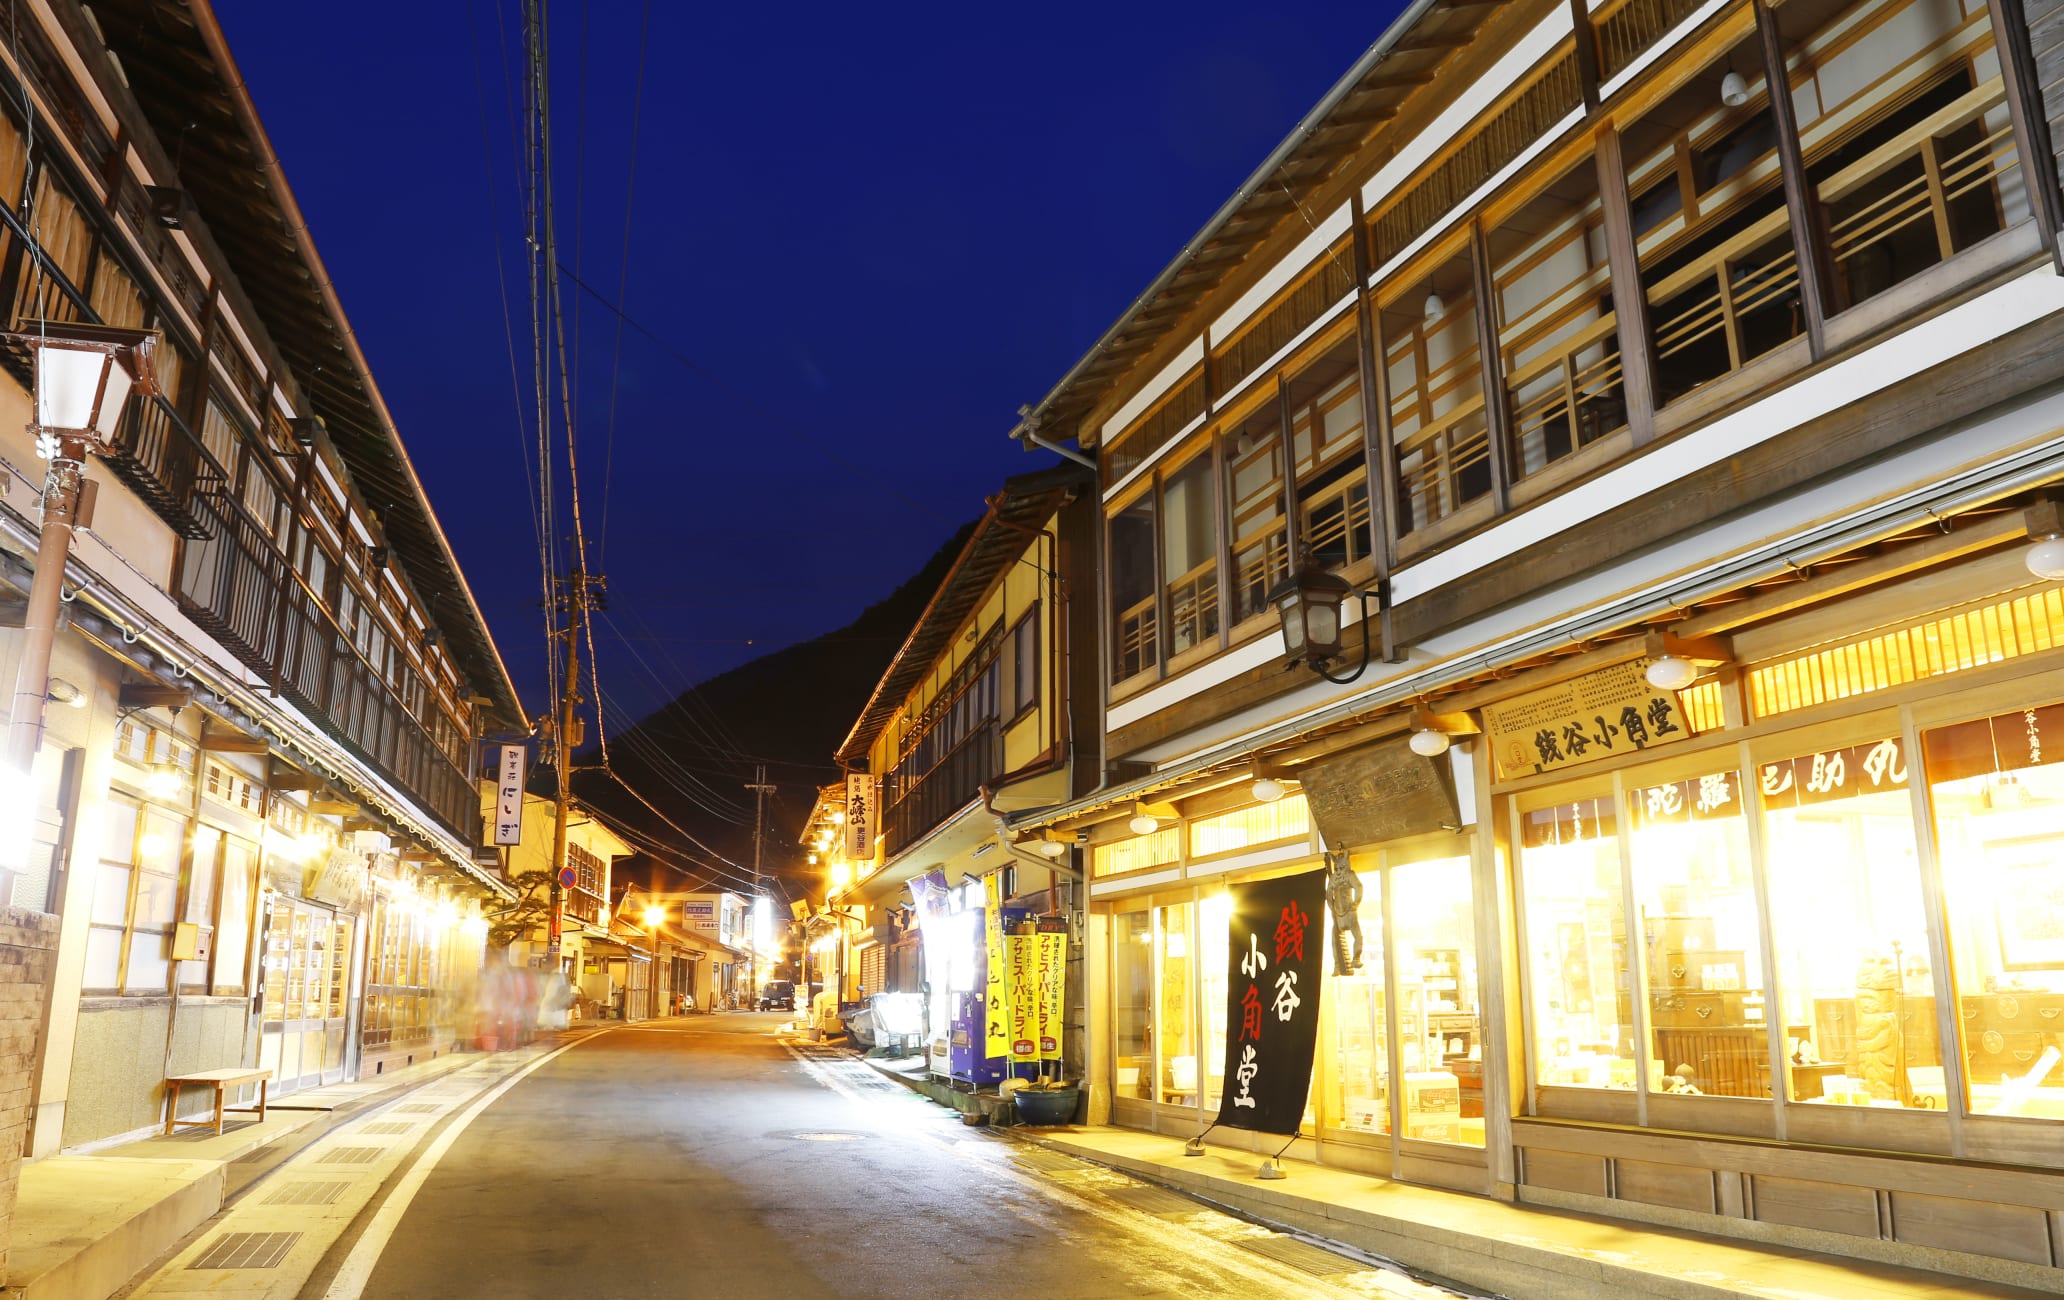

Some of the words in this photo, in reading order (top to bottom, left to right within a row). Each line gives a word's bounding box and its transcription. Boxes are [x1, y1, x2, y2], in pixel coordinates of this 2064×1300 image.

[2024, 708, 2041, 763] 谷小角堂
[1013, 937, 1026, 1039] アサヒスーパードライ
[1038, 935, 1051, 1037] アサヒスーパードライ
[1270, 900, 1309, 1022] 銭谷
[1233, 933, 1268, 1109] 小角堂
